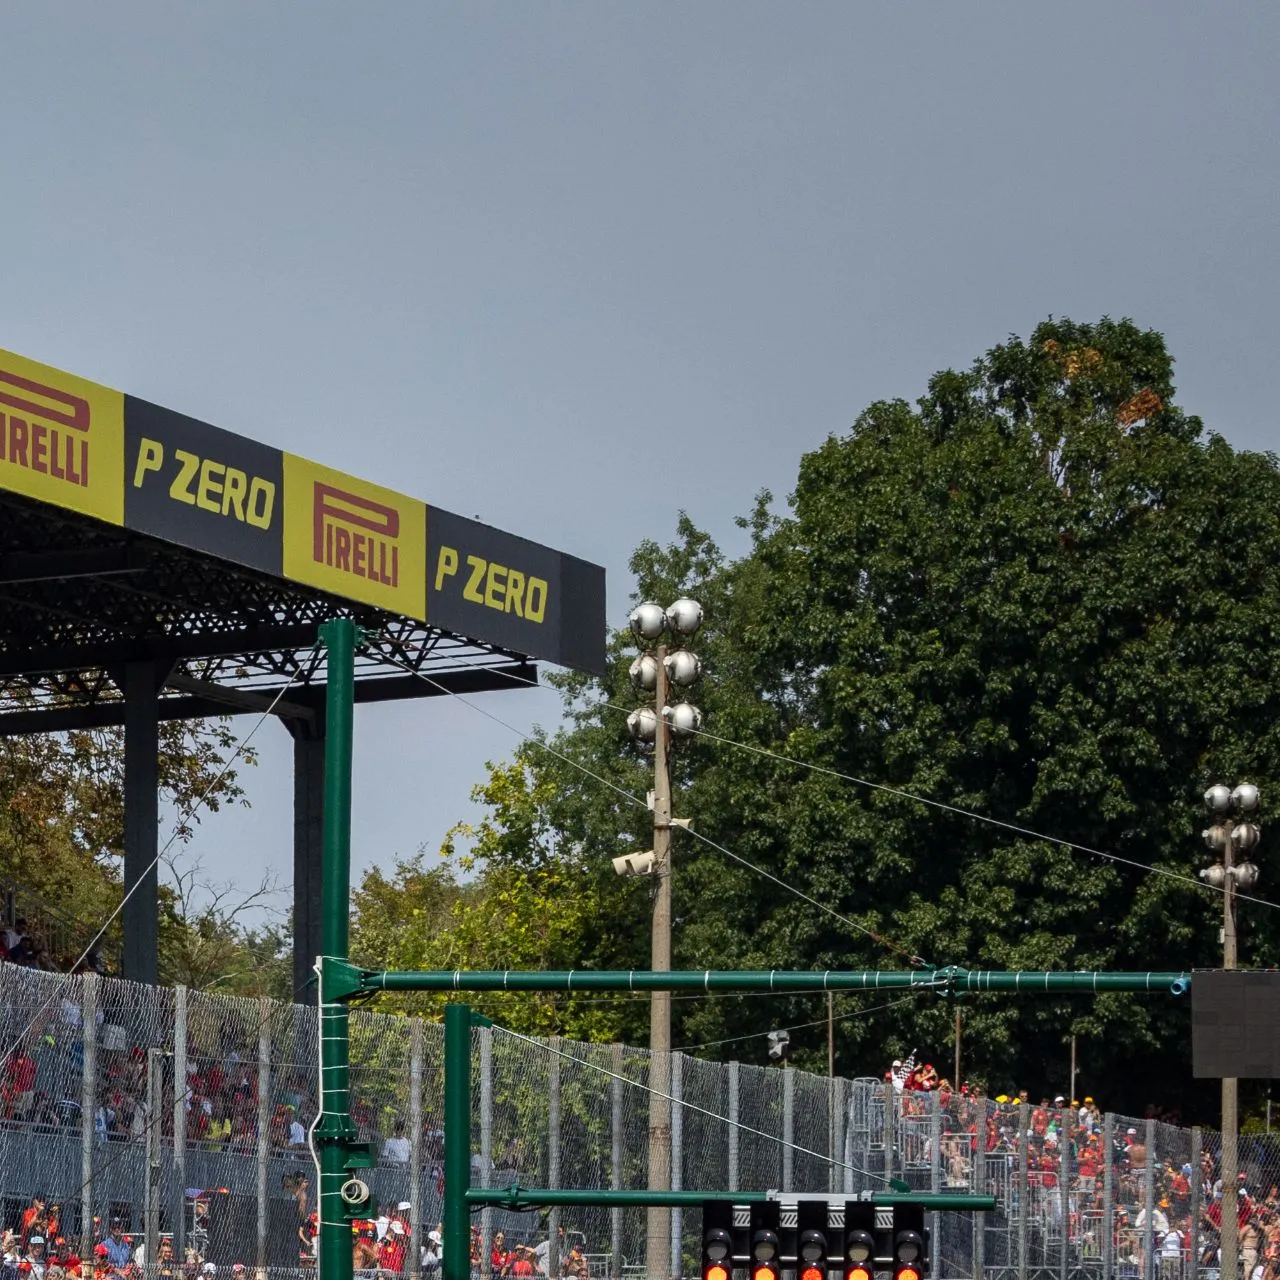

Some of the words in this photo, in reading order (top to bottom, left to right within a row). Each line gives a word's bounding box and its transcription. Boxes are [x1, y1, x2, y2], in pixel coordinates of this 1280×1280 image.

[135, 439, 162, 486] P
[170, 451, 274, 528] ZERO
[313, 483, 399, 587] PIRELLI
[436, 548, 457, 589] P
[464, 557, 547, 622] ZERO
